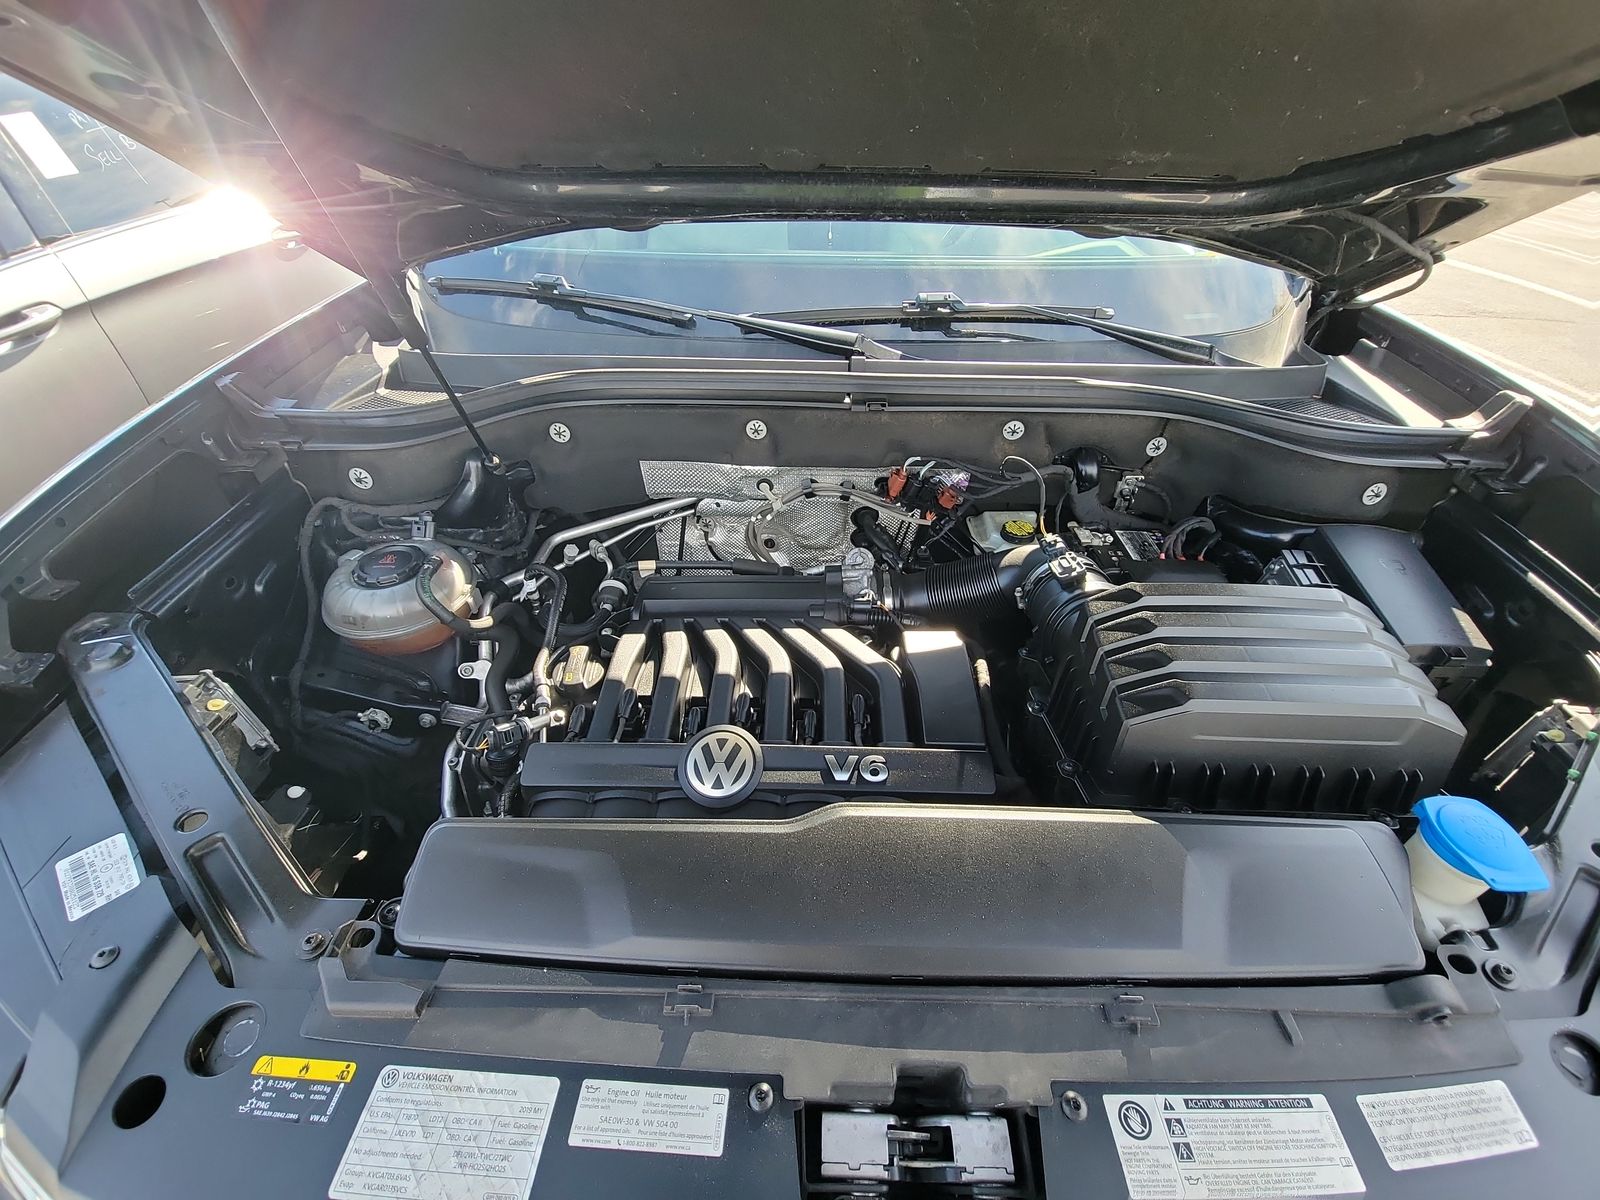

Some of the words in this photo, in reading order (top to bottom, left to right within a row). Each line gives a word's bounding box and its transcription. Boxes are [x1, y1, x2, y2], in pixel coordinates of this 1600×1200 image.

[84, 144, 122, 171] SELL
[686, 731, 754, 797] VW
[824, 754, 889, 782] V6
[401, 1072, 453, 1082] VOLKSWAGEN
[266, 1080, 296, 1090] R-1234yf
[477, 1087, 517, 1095] INFORMATION
[607, 1088, 629, 1097] Engine
[1186, 1100, 1224, 1108] ACHTUNG
[612, 1116, 633, 1125] 0W-30
[512, 1122, 538, 1130] Gasoline
